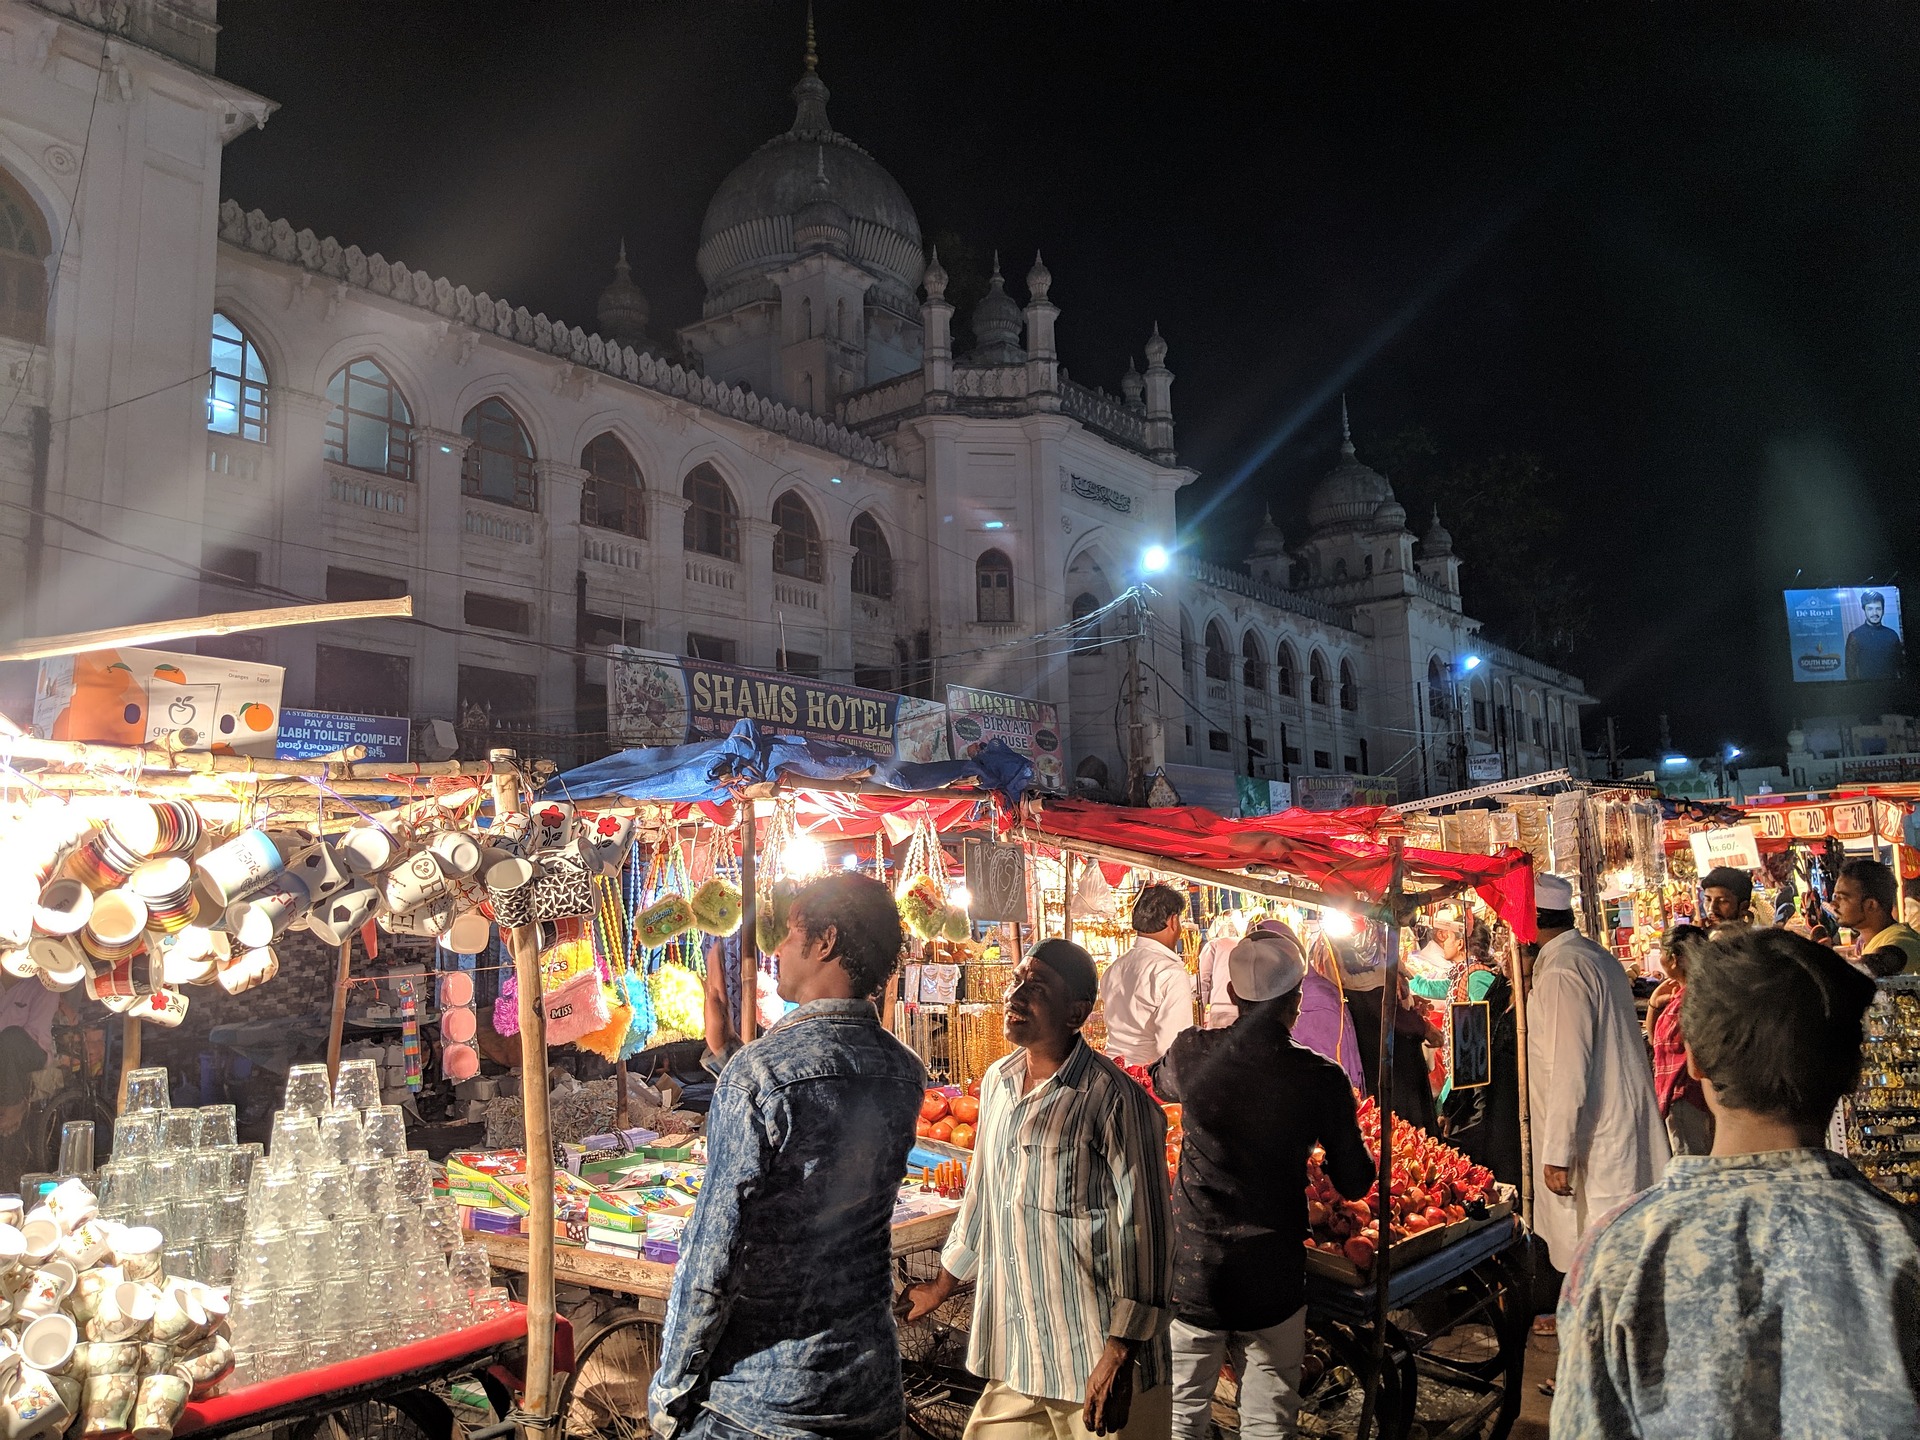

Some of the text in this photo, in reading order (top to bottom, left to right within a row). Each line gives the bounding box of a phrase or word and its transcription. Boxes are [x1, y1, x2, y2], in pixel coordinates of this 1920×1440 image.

[1810, 609, 1834, 617] Royal
[693, 671, 894, 739] SHAMS HOTEL
[968, 692, 1040, 721] ROSHAN
[293, 710, 319, 718] SYMBOL
[331, 714, 376, 723] CLEANLINESS
[304, 719, 356, 730] PAY & USE
[983, 716, 1033, 736] BIRYANI
[313, 729, 352, 742] TOILET
[354, 732, 402, 746] COMPLEX
[840, 737, 892, 754] FAMILY SECTION
[1844, 759, 1901, 769] KITCHEN
[551, 1004, 573, 1019] MISS
[590, 1216, 608, 1225] GOLD
